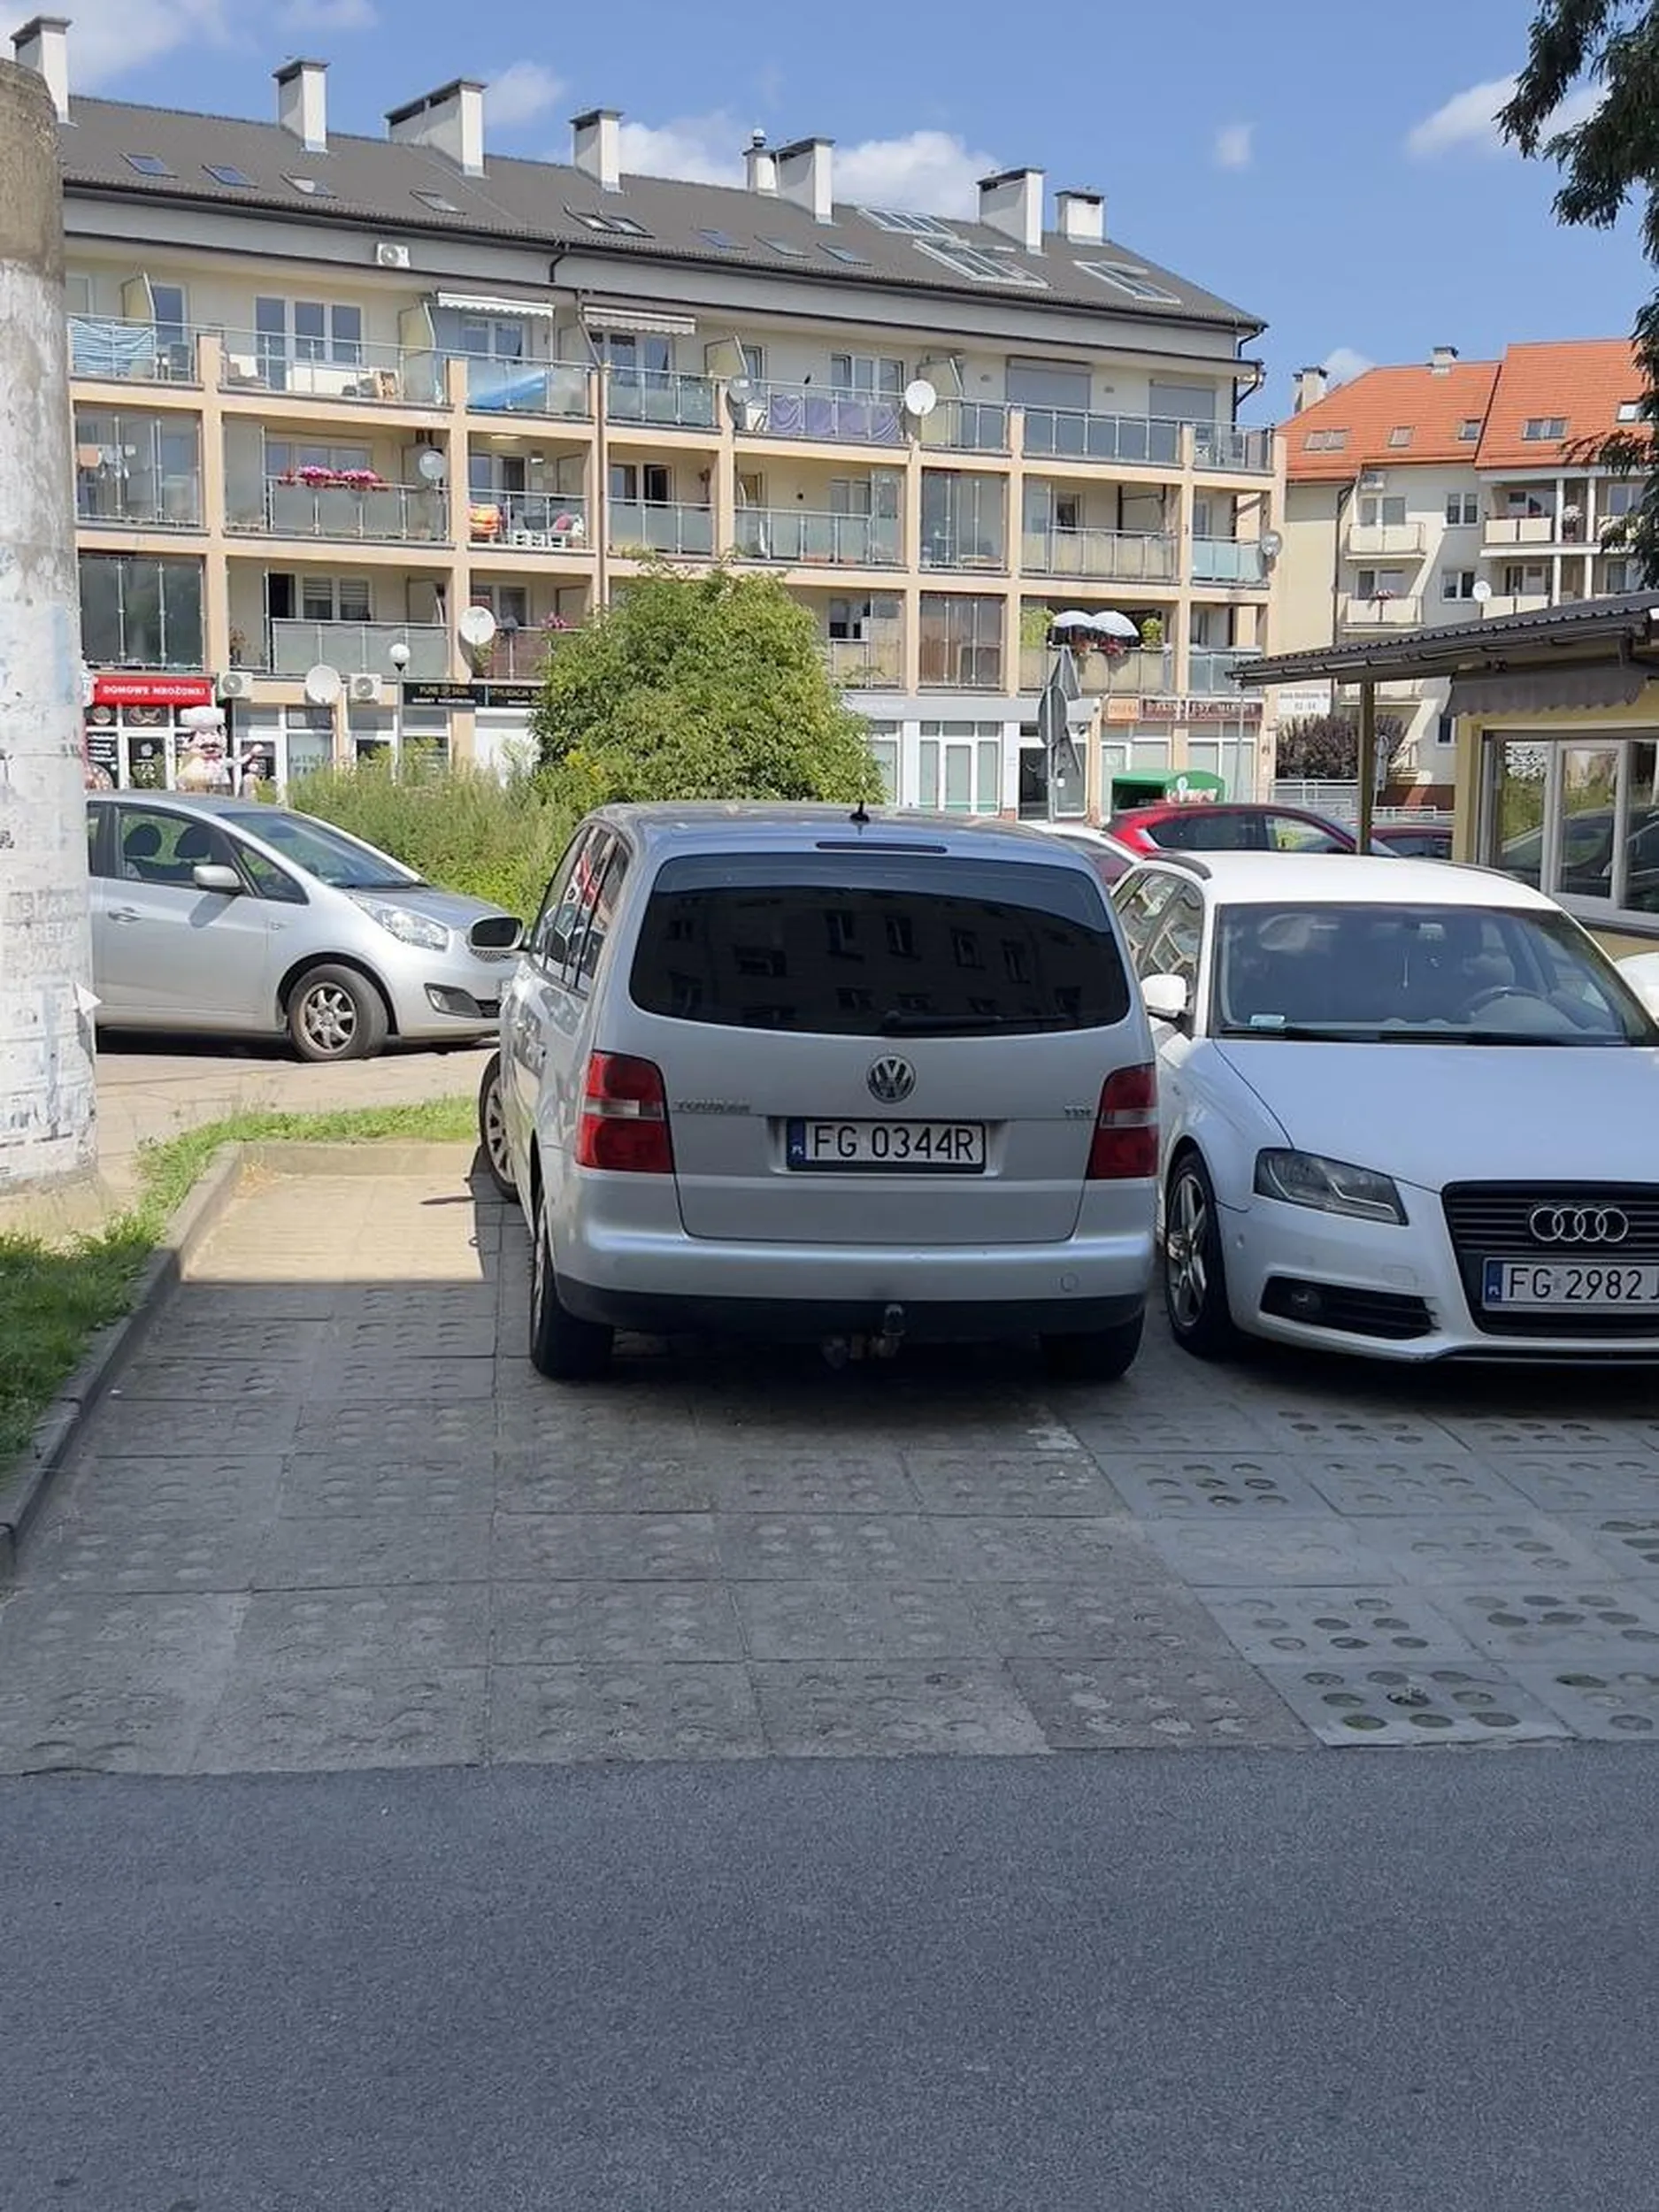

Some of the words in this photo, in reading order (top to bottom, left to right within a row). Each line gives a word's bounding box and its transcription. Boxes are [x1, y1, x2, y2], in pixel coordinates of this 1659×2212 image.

[103, 685, 149, 695] DOMOWE
[814, 1125, 857, 1158] FG
[871, 1125, 974, 1161] 0344R
[1509, 1267, 1552, 1299] FG
